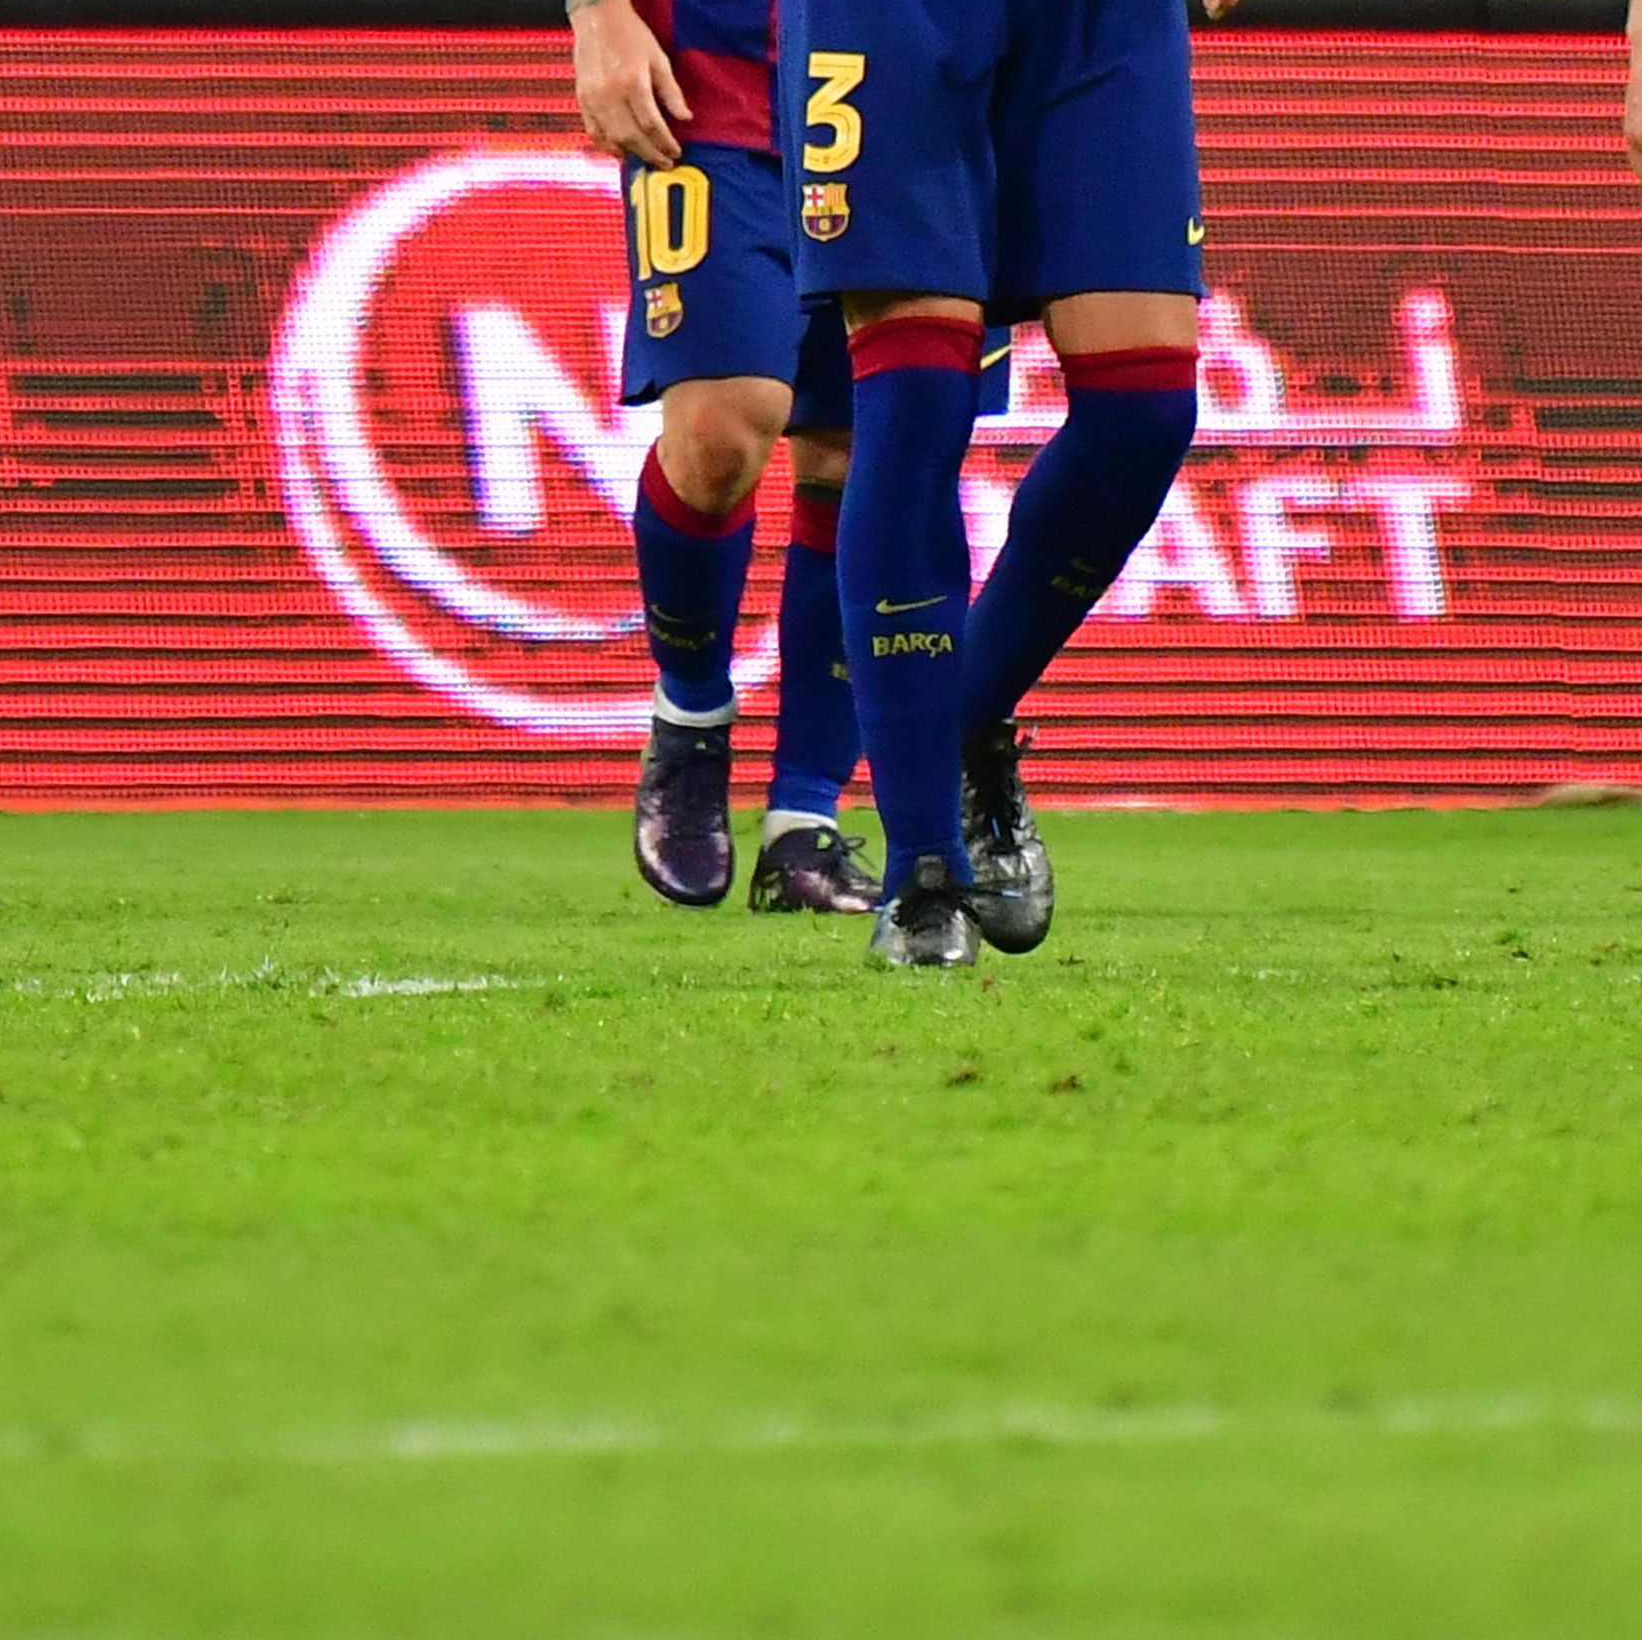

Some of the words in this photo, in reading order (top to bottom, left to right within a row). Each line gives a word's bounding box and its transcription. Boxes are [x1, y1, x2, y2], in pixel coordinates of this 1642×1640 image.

[803, 51, 866, 173] 3
[630, 164, 710, 281] 10
[872, 631, 954, 659] BARÇA
